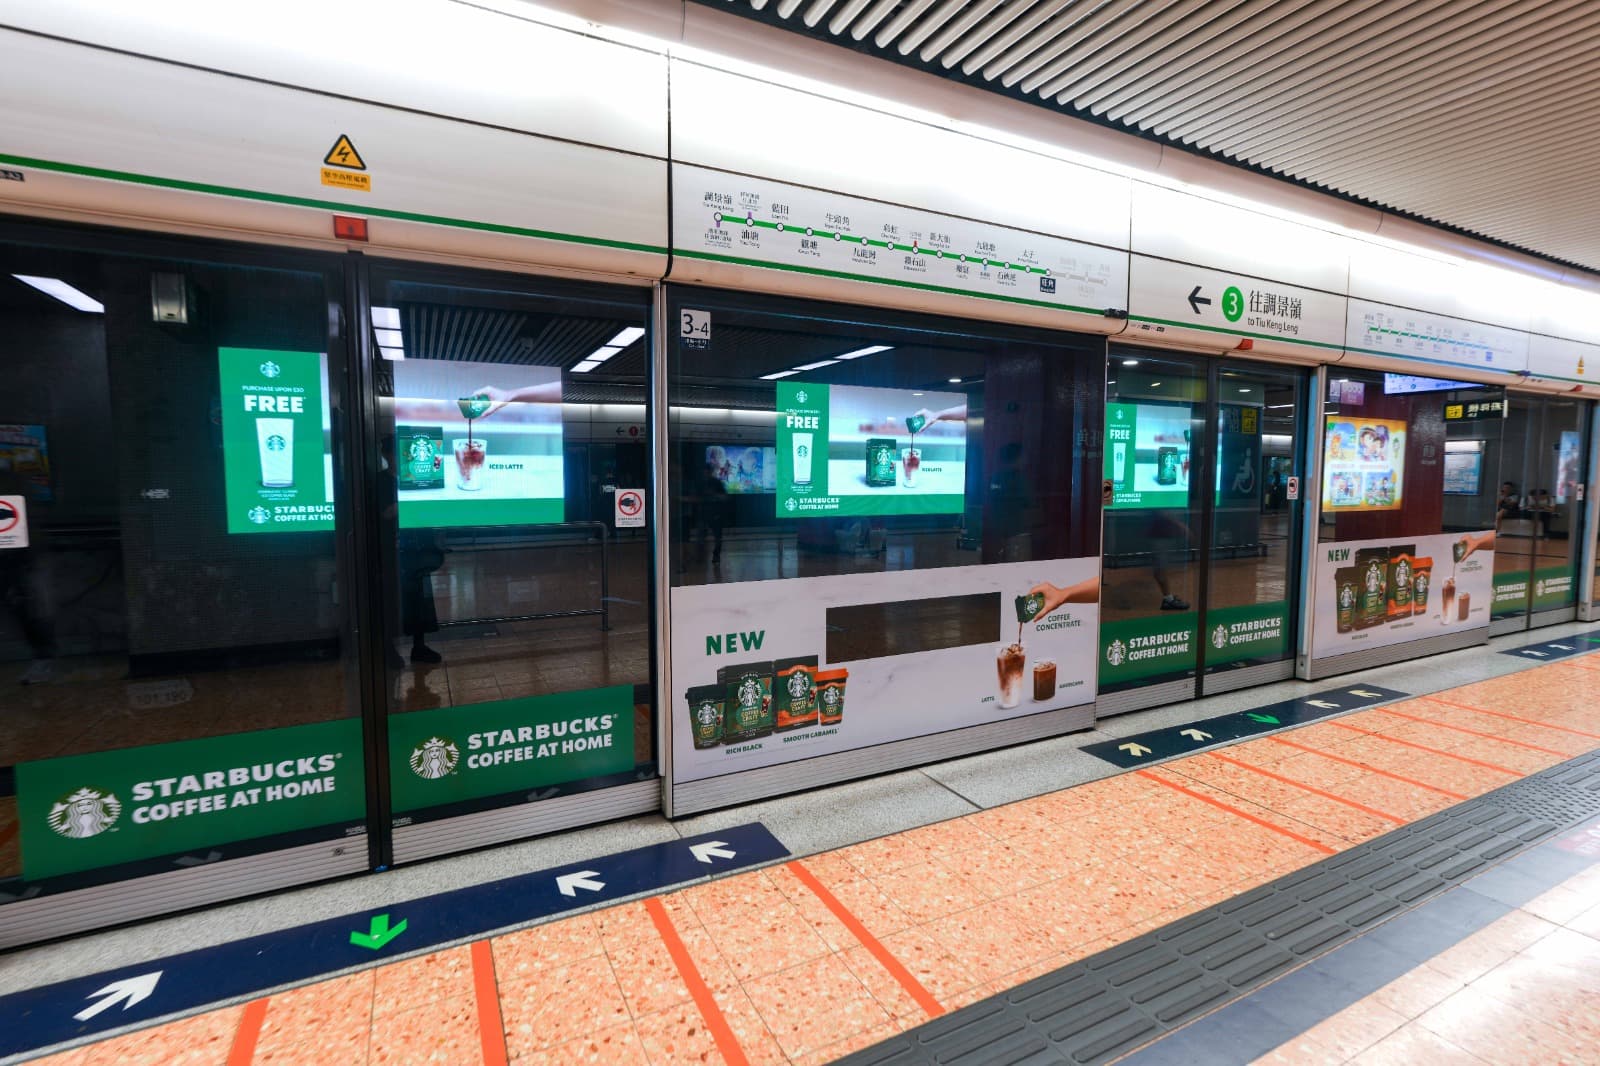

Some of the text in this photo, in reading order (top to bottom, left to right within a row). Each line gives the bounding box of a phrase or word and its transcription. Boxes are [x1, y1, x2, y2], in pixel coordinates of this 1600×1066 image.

[1228, 291, 1238, 316] 3
[1249, 290, 1302, 320] 往調景嶺
[682, 313, 709, 336] 3-4
[1247, 317, 1299, 335] to Tiu Keng Leng
[243, 394, 304, 413] FREE
[786, 415, 819, 430] FREE
[1109, 429, 1130, 440] FREE
[274, 505, 334, 514] STARBUC
[274, 514, 307, 522] COFFEE
[320, 513, 335, 521] HO
[1327, 547, 1350, 563] NEW
[1036, 620, 1081, 632] CONCENTRATE
[1047, 613, 1071, 623] COFFEE
[1230, 617, 1281, 633] STARBUCKS
[705, 630, 766, 656] NEW
[1129, 630, 1190, 649] STARBUCKS
[1230, 628, 1280, 645] COFFEE AT HOME
[1128, 643, 1189, 661] COFFEE AT HOME
[467, 714, 613, 750] STARBUCKS
[783, 734, 810, 743] SMOOTH
[467, 733, 613, 769] COFFEE AT HOME
[725, 743, 763, 755] RICH BLACK
[131, 754, 336, 802] STARBUCKS
[131, 776, 336, 825] COFFEE AT HOME
